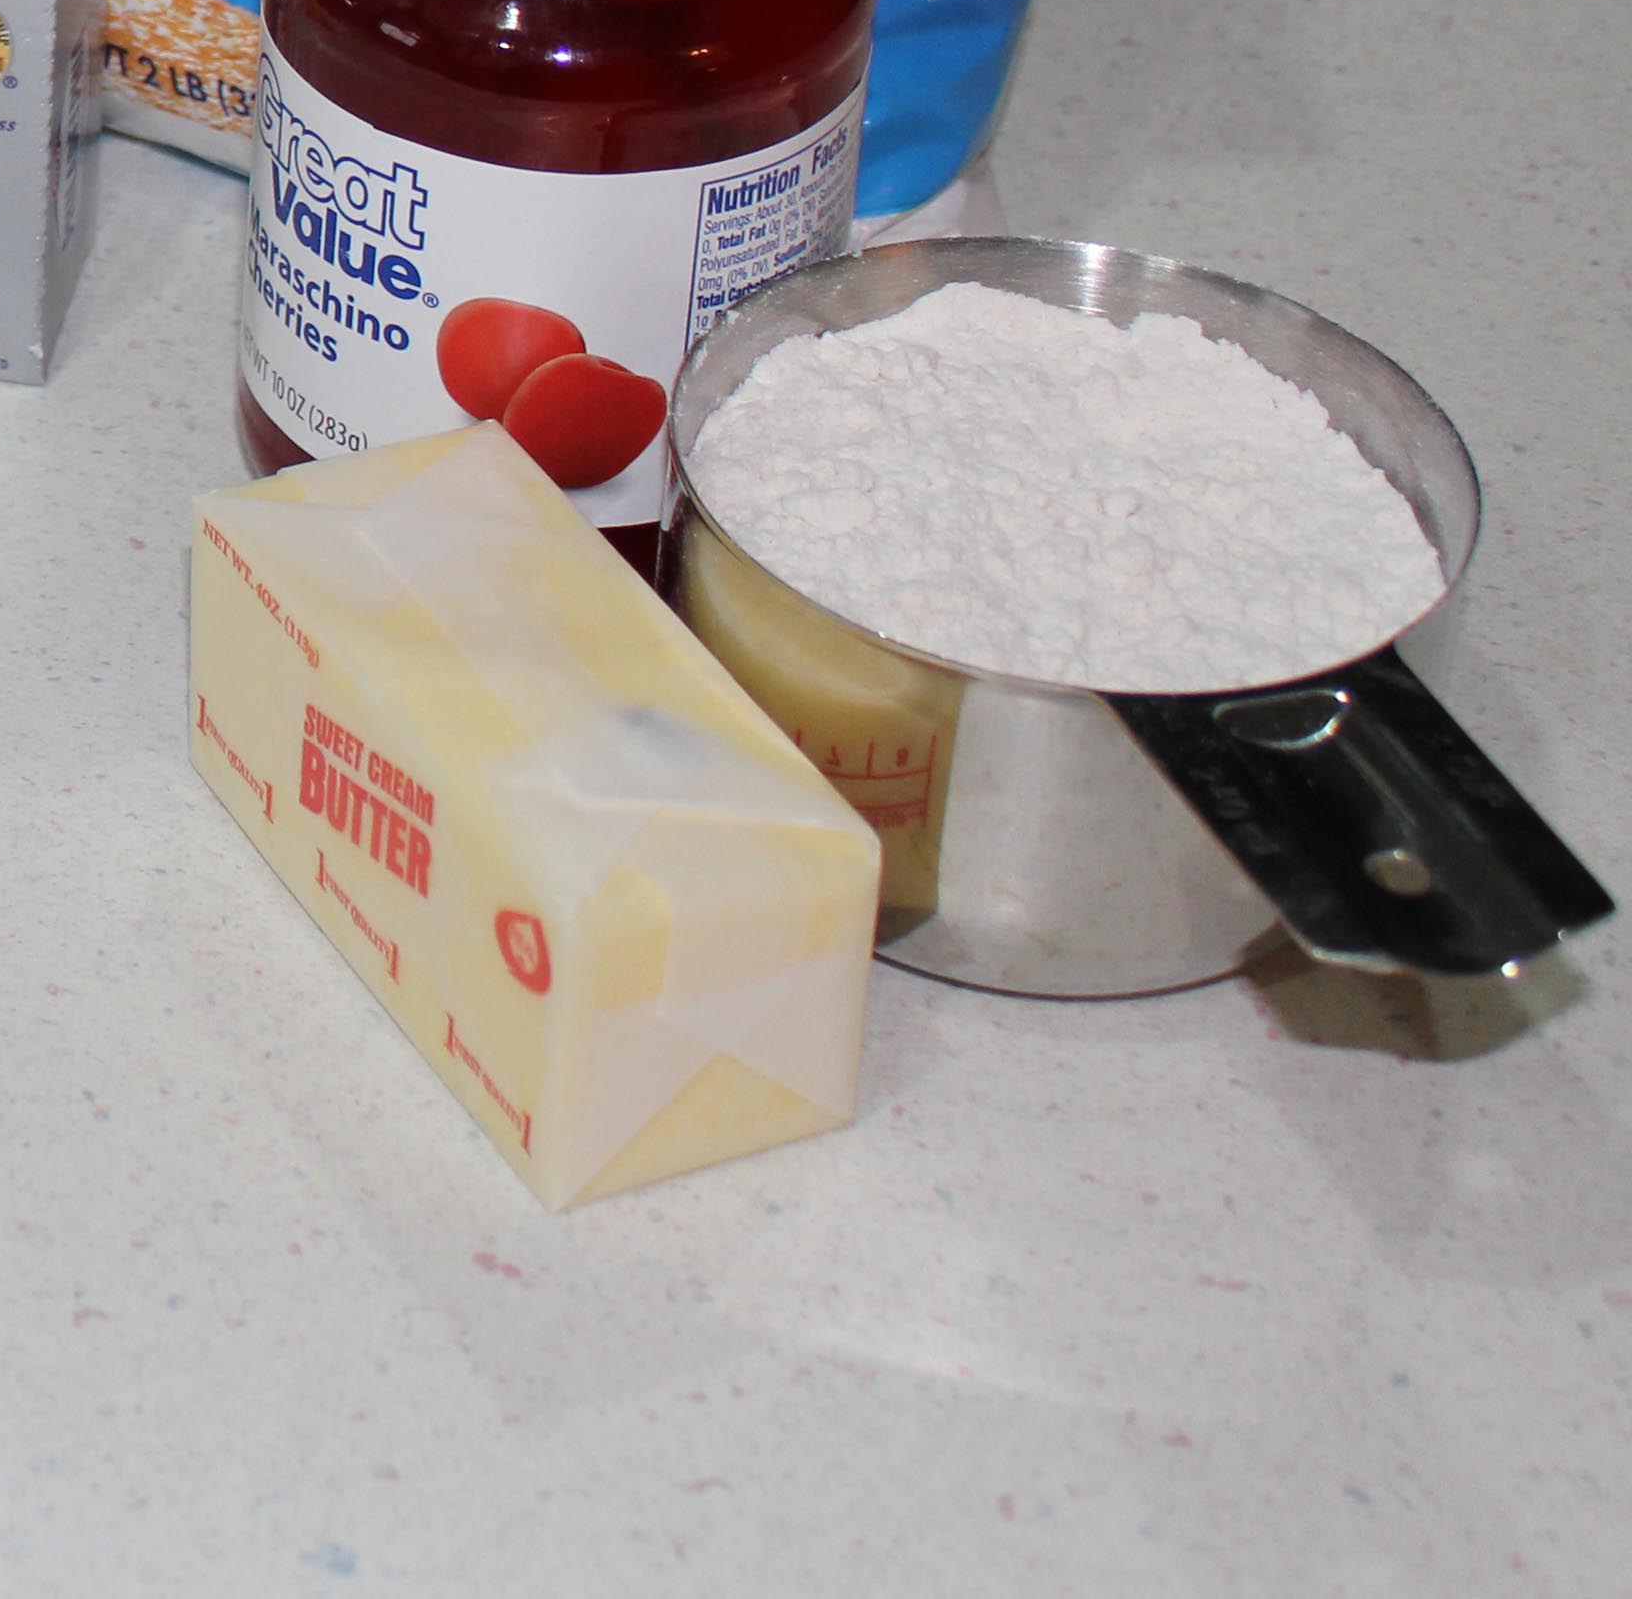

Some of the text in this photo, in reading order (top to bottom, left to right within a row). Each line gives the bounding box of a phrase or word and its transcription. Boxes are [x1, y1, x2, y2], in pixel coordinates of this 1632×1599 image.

[138, 55, 207, 103] 2 LB
[254, 51, 429, 251] Great
[707, 163, 801, 217] Nutrition
[811, 125, 848, 176] Facts
[271, 159, 423, 300] Value
[704, 200, 783, 236] Servings: About
[716, 231, 745, 251] Total
[748, 224, 767, 242] Fat
[251, 194, 411, 351] Maraschino
[697, 272, 724, 293] 0mg
[725, 263, 748, 286] (0%
[773, 239, 808, 268] Sodium
[700, 236, 782, 274] Polyunsaturated
[696, 290, 726, 311] Total
[271, 369, 285, 401] 10
[286, 385, 306, 421] OZ
[202, 517, 231, 558] NET
[230, 547, 255, 591] WT.
[303, 702, 435, 828] SWEET CREAM
[298, 736, 434, 900] BUTTER
